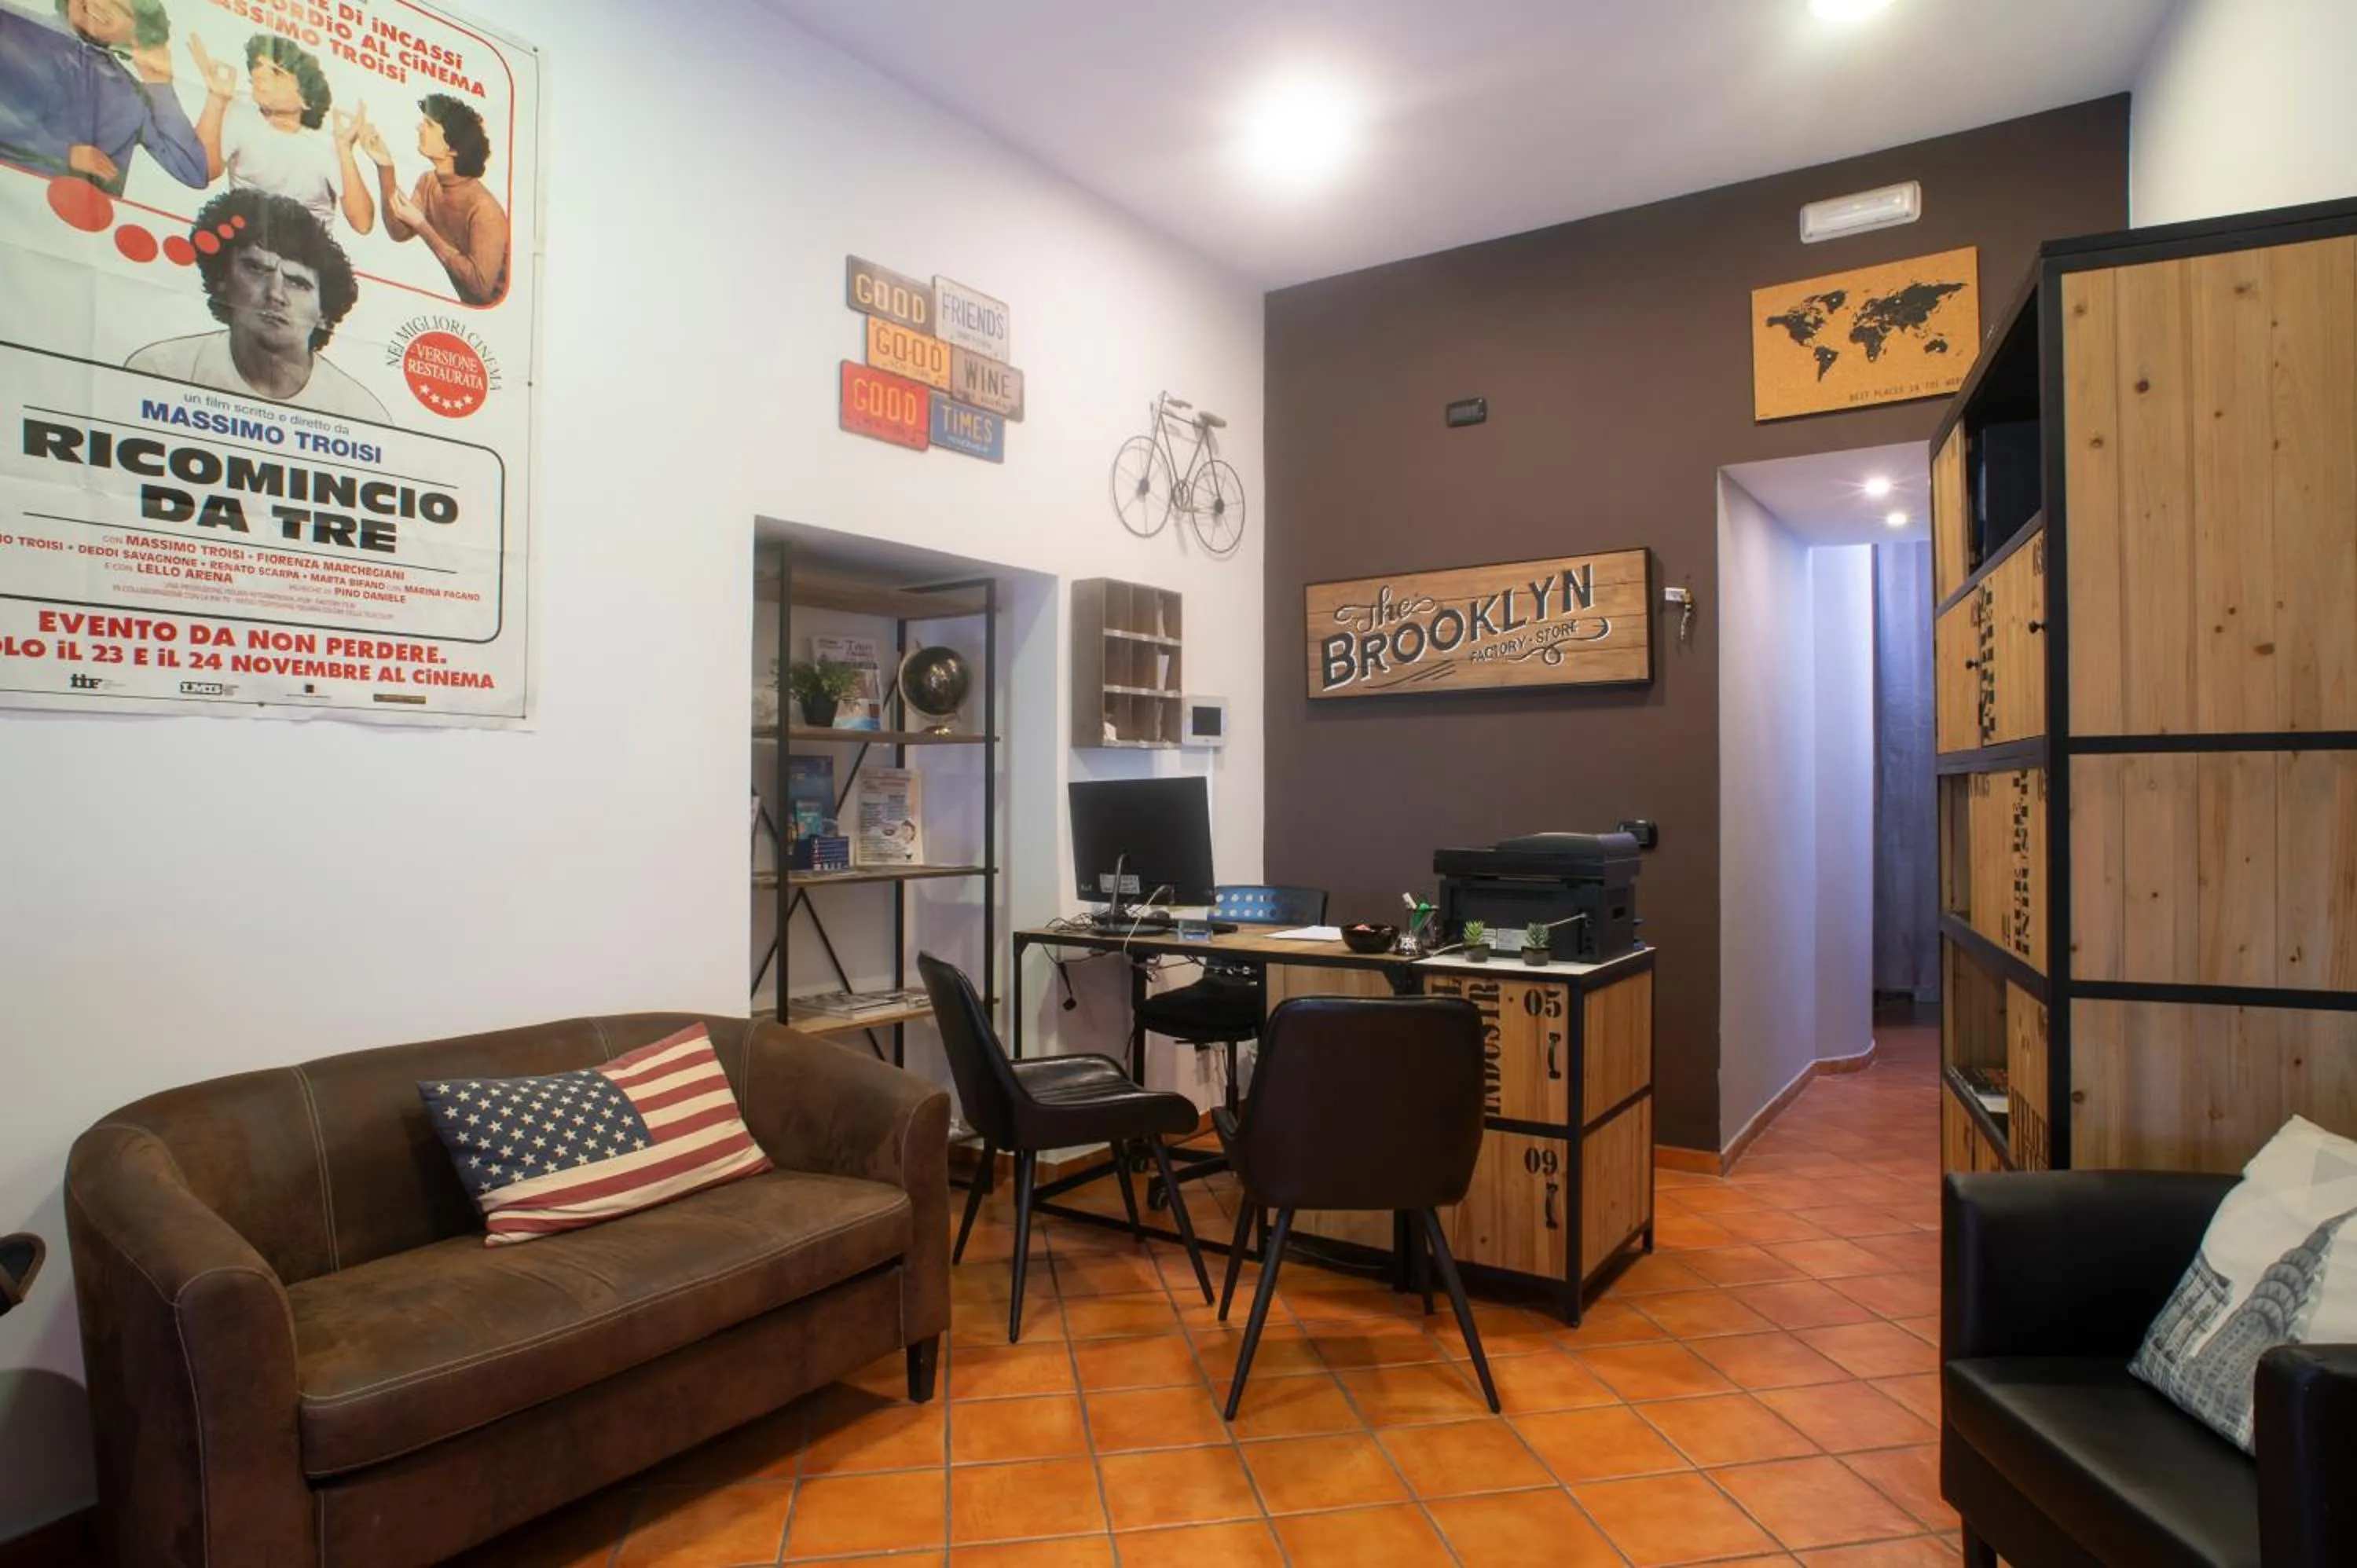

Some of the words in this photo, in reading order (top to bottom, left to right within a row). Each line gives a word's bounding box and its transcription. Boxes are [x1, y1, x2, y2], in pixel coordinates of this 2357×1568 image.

[361, 34, 390, 59] AL
[856, 273, 926, 324] GOOD
[941, 291, 1005, 340] FRIENDS
[395, 315, 467, 343] MIGLIORI
[875, 325, 943, 374] GOOD
[408, 358, 484, 390] RESTAURATA
[416, 343, 478, 373] VERSIONE
[964, 357, 1014, 400] WINE
[184, 394, 201, 405] un
[206, 396, 231, 412] film
[234, 403, 275, 421] scritto
[279, 413, 288, 422] e
[290, 413, 332, 431] diretto
[334, 424, 350, 435] da
[853, 377, 918, 426] GOOD
[141, 398, 284, 445] MASSIMO
[295, 430, 382, 464] TROISI
[942, 405, 994, 445] TIMES
[22, 418, 459, 525] RICOMINCIO
[140, 482, 250, 533] DA
[272, 504, 396, 553] TRE
[18, 537, 64, 551] TROISI
[79, 544, 119, 558] DEDDI
[123, 550, 197, 567] SAVAGNONE
[210, 560, 255, 575] RENATO
[258, 566, 299, 580] SCARPA
[126, 535, 196, 554] MASSIMO
[200, 544, 244, 560] TROISI
[257, 552, 319, 570] FIORENZA
[323, 561, 405, 580] MARCHEGIANI
[137, 562, 181, 577] LELLO
[185, 569, 233, 584] ARENA
[334, 587, 361, 599] PINO
[363, 590, 407, 604] DANIELE
[1334, 584, 1439, 632] The
[38, 610, 178, 642] EVENTO
[189, 625, 236, 647] DA
[247, 629, 316, 654] NON
[326, 636, 448, 665] PERDERE.
[1321, 562, 1596, 691] BROOKLYN
[92, 644, 124, 664] 23
[134, 647, 148, 665] E
[189, 652, 222, 670] 24
[231, 654, 370, 681] NOVEMBRE
[377, 666, 406, 683] AL
[1469, 636, 1528, 665] FACTORY
[1523, 987, 1563, 1019] 05
[1524, 1147, 1559, 1176] 09
